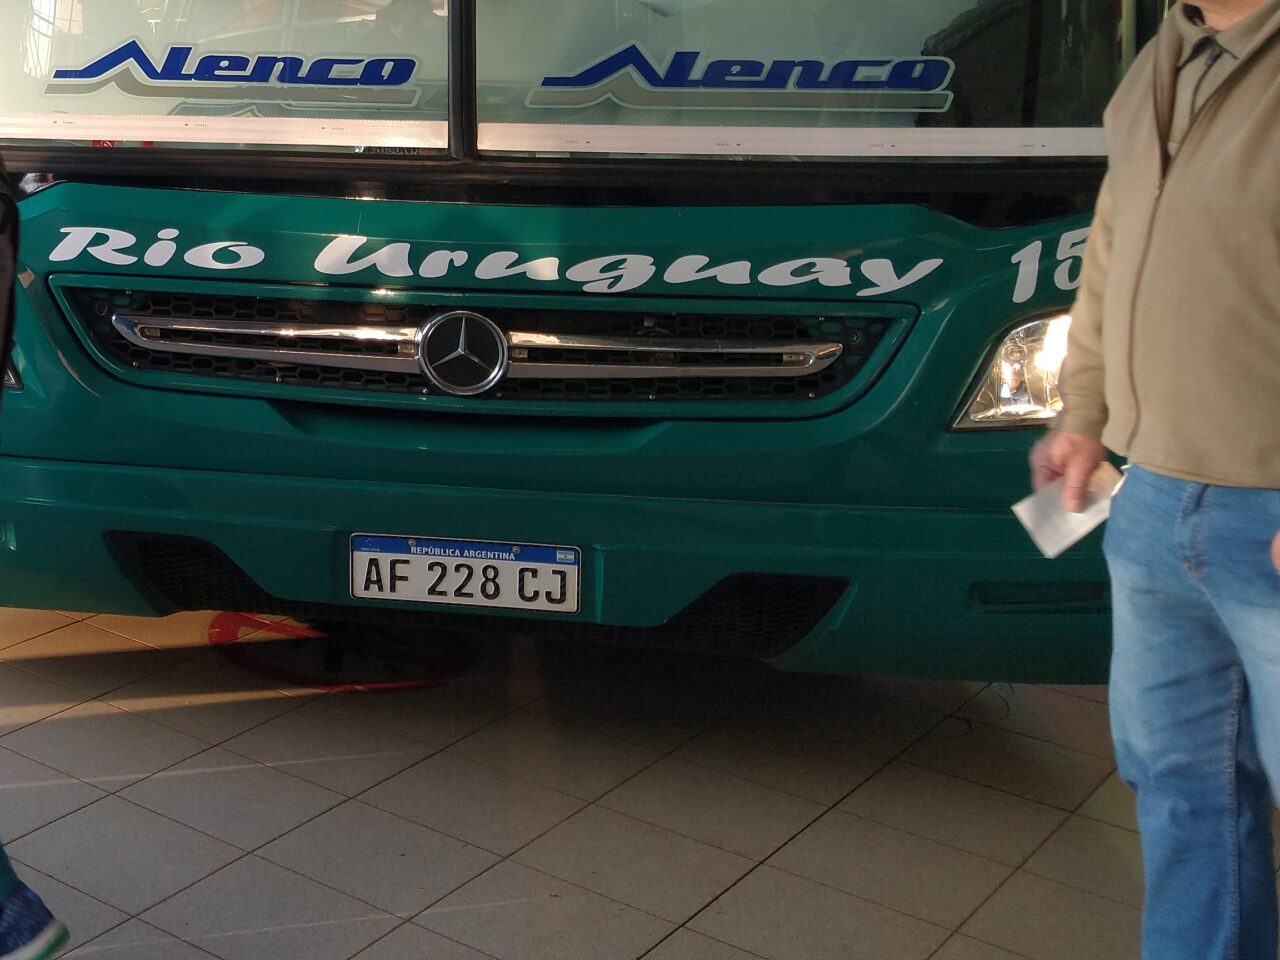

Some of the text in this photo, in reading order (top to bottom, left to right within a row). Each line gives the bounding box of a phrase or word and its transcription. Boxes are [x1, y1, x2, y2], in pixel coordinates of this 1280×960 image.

[52, 39, 417, 86] Alenco
[541, 44, 951, 92] Alenco
[48, 226, 944, 297] Rio Uruguay
[410, 544, 516, 561] REPÚBLICA ARGENTINA
[363, 557, 568, 605] AF 228 CJ
